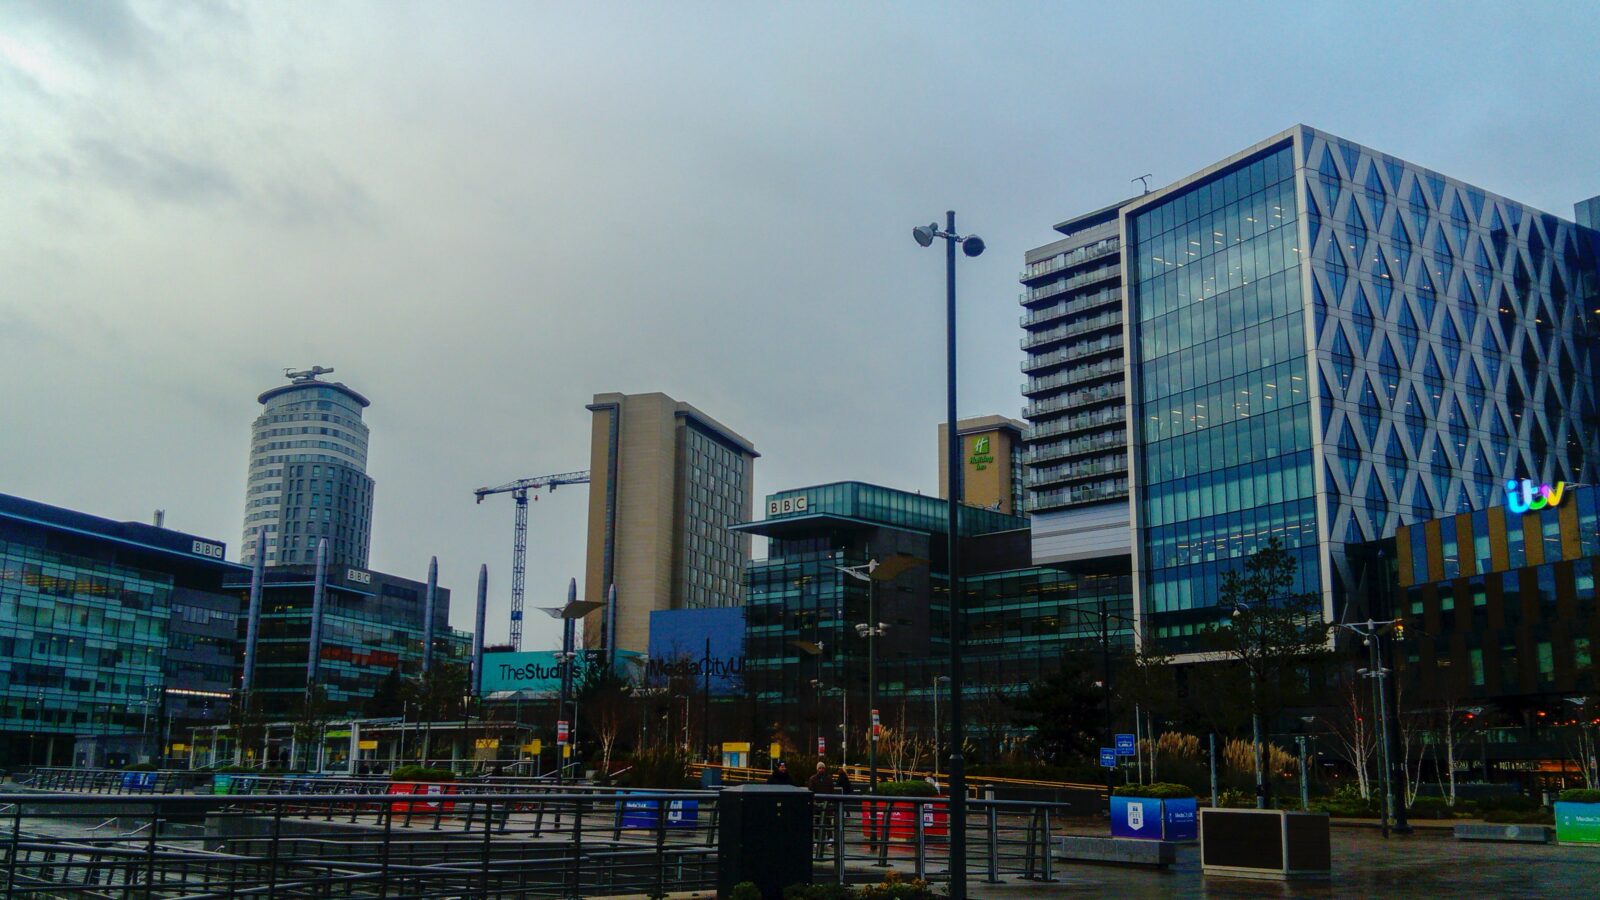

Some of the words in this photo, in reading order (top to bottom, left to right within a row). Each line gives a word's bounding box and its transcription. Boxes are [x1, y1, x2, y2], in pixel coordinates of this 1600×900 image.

[969, 455, 993, 464] Holiday
[1507, 479, 1565, 513] itv
[771, 497, 805, 513] BBC
[195, 542, 222, 557] BBC
[349, 570, 369, 583] BBC
[499, 663, 581, 681] TheStudis
[646, 656, 745, 678] MediaCityU
